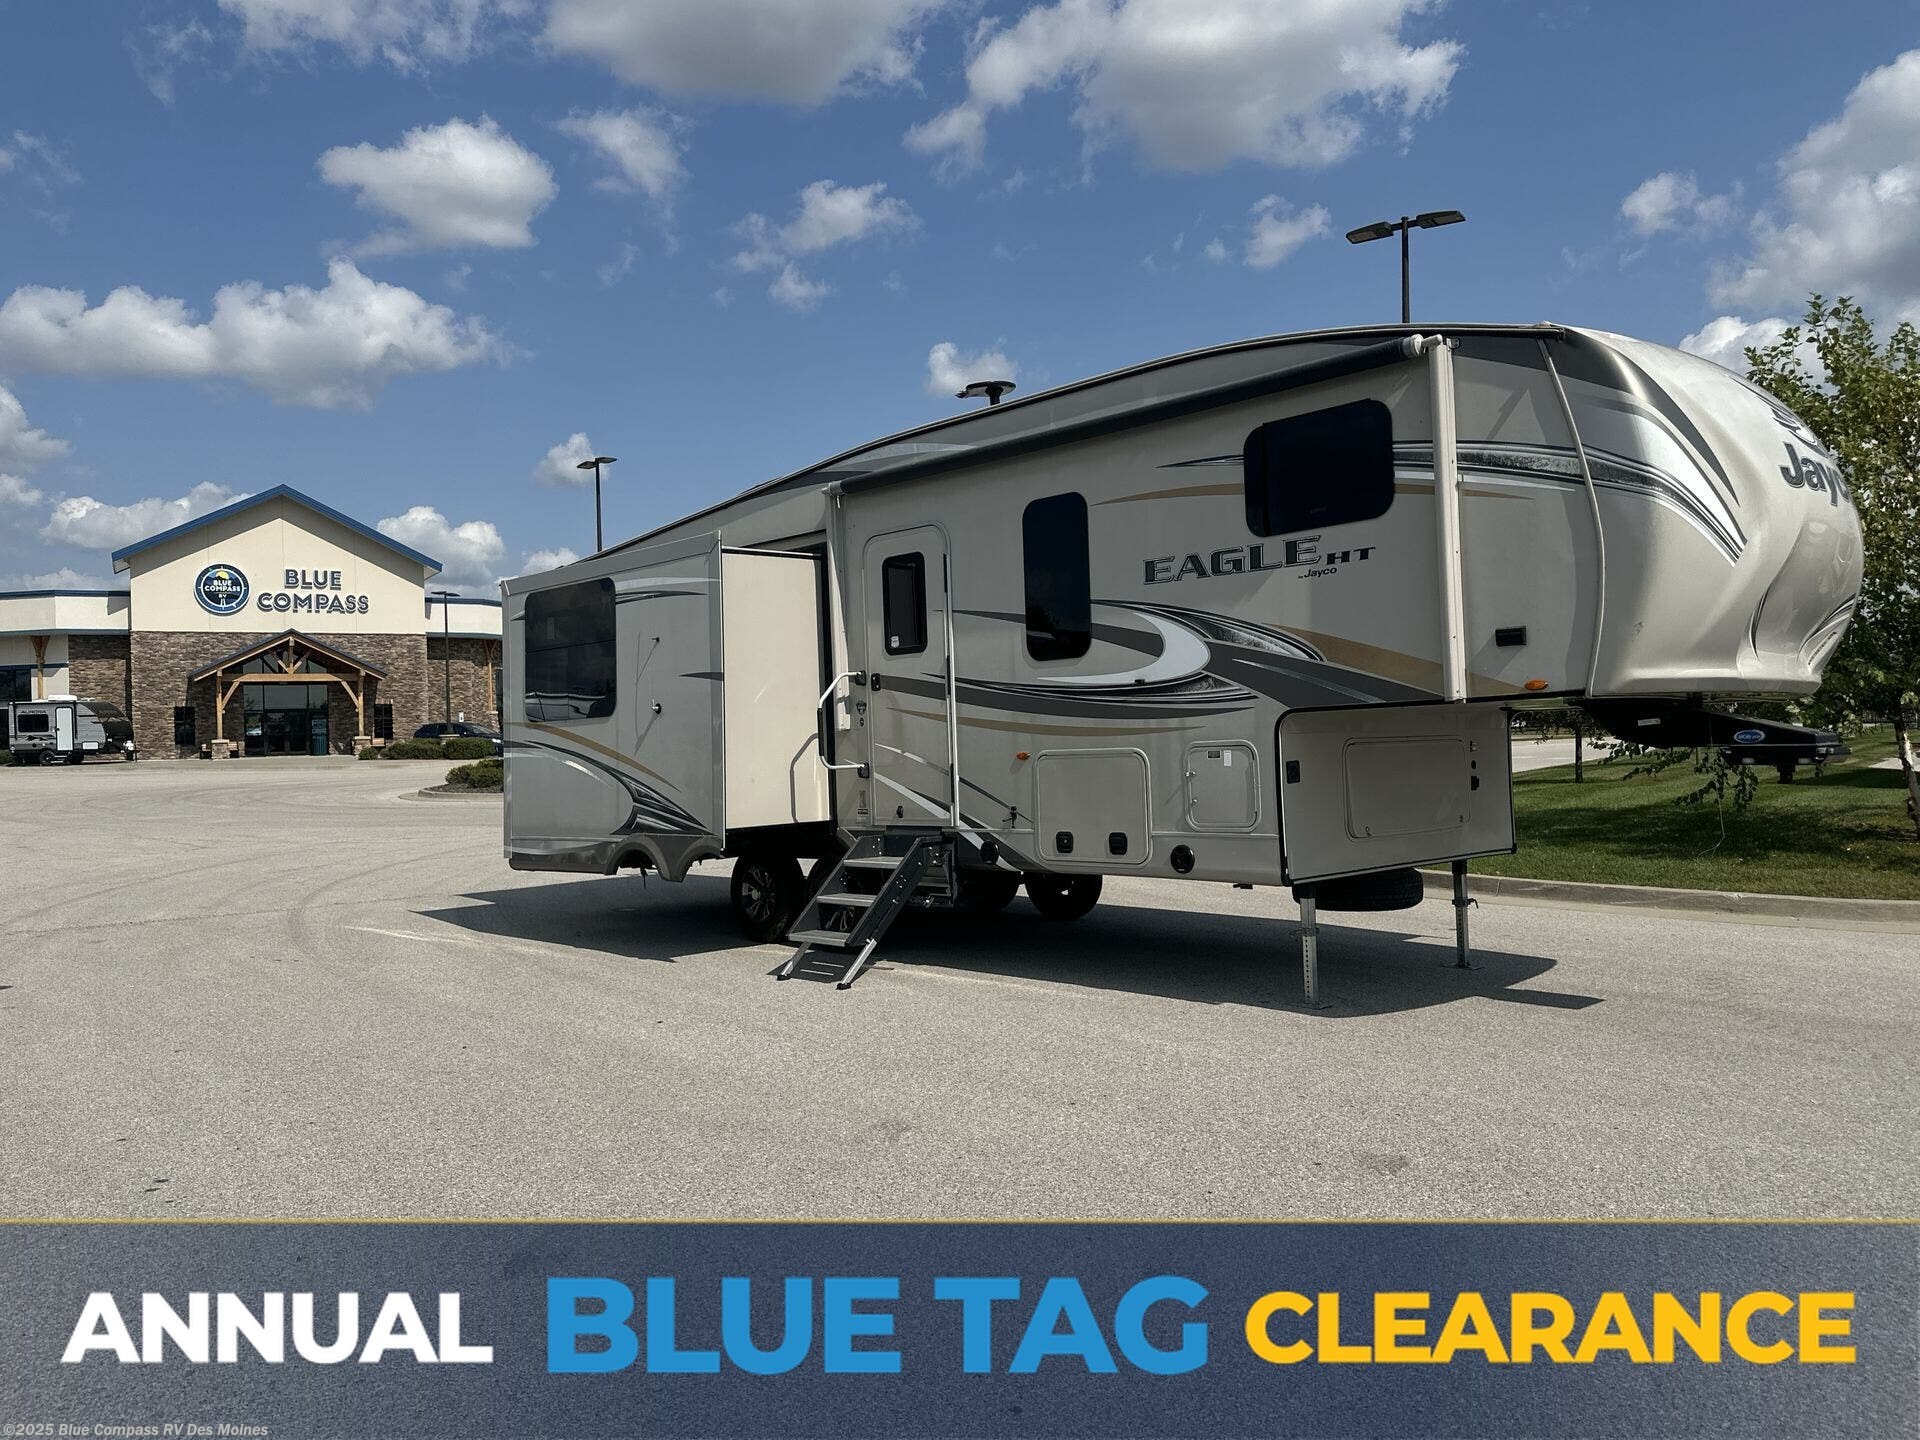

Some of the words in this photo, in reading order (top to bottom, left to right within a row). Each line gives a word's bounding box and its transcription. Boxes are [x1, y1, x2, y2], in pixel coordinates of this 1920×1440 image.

[1143, 535, 1321, 585] EAGLE
[1326, 546, 1376, 566] HT
[284, 569, 342, 590] BLUE
[1303, 567, 1338, 578] Jayco
[256, 592, 369, 614] COMPASS
